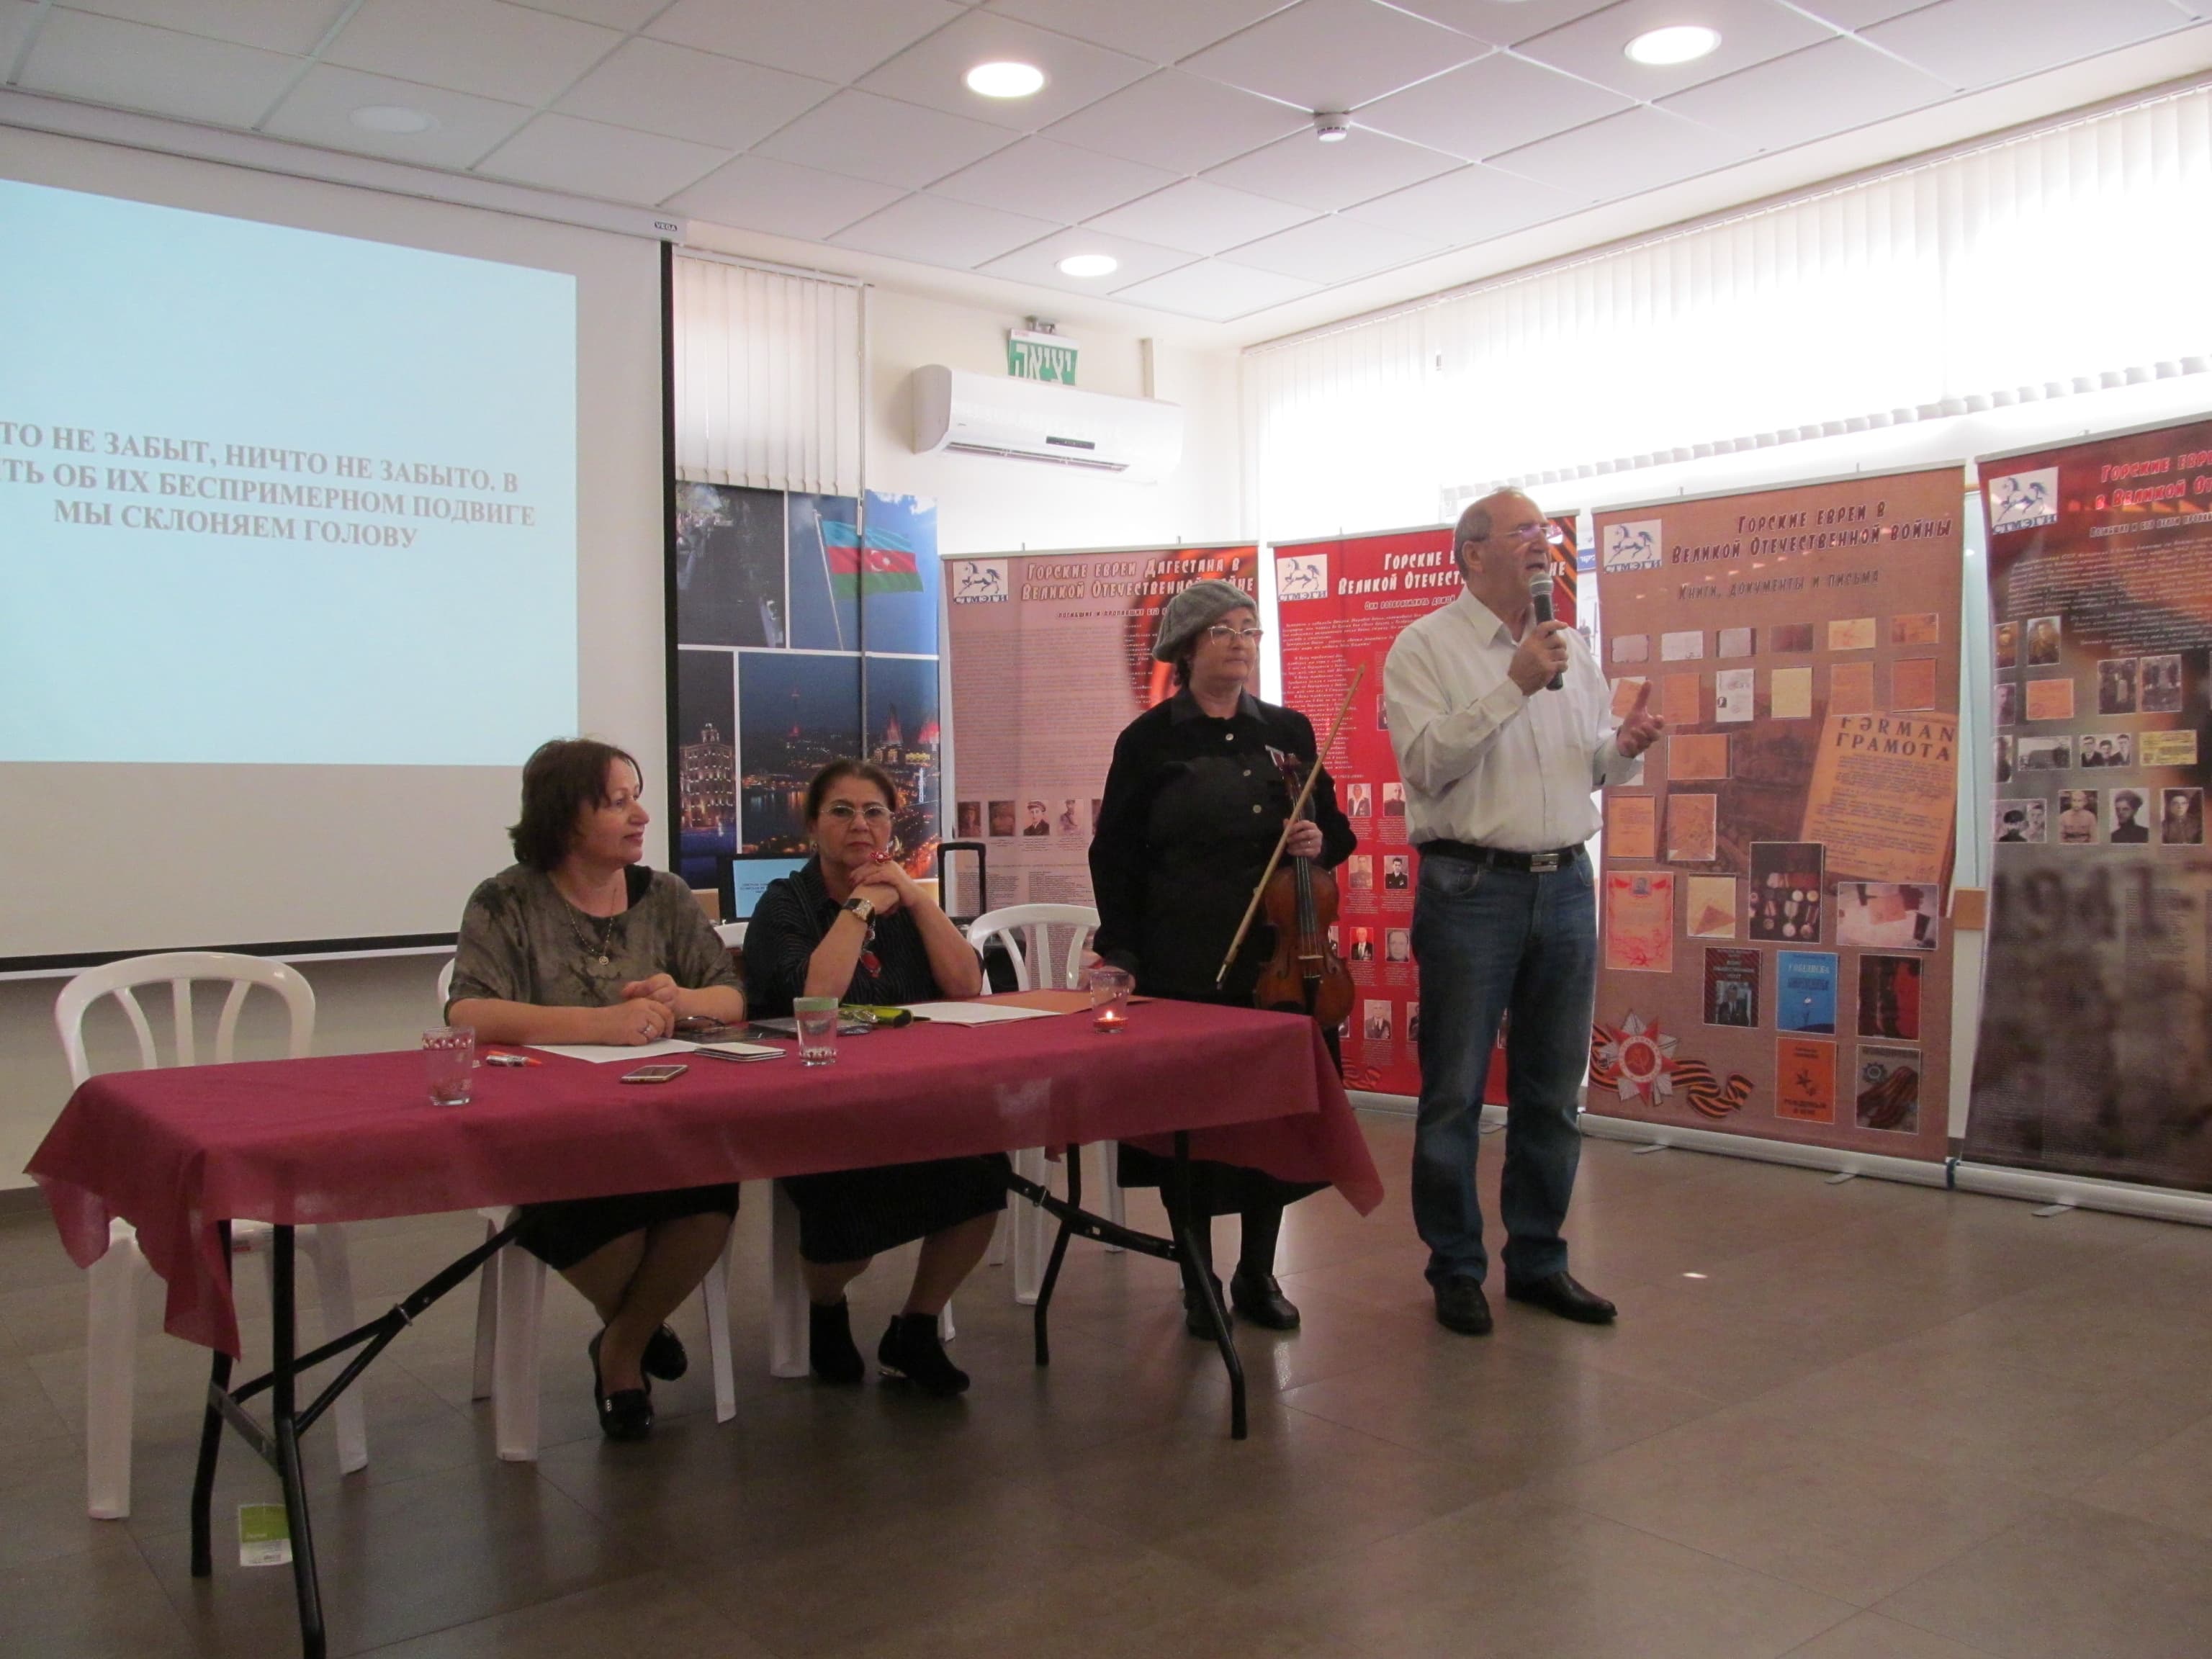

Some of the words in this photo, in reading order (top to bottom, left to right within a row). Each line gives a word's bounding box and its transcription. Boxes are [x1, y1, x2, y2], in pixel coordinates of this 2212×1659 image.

[1014, 343, 1071, 383] יציאה
[0, 421, 43, 448] ТО
[52, 426, 95, 453] НЕ
[104, 432, 217, 467] ЗАБЫТ,
[225, 444, 328, 475] НИЧТО
[336, 455, 372, 480] НЕ
[380, 459, 495, 493] ЗАБЫТО.
[503, 472, 518, 493] В
[1, 457, 45, 485] ТЬ
[53, 463, 97, 489] ОБ
[107, 467, 148, 493] ИХ
[158, 475, 405, 516] БЕСПРИМЕРНОМ
[413, 495, 536, 527] ПОДВИГЕ
[54, 499, 112, 526] МЫ
[121, 504, 295, 541] СКЛОНЯЕМ
[304, 519, 418, 549] ГОЛОВУ
[1604, 559, 1661, 573] СТМЭГИ
[1092, 577, 1202, 598] ОТЕЧЕСТВЕННО
[1837, 732, 1950, 761] ГРАМОТА
